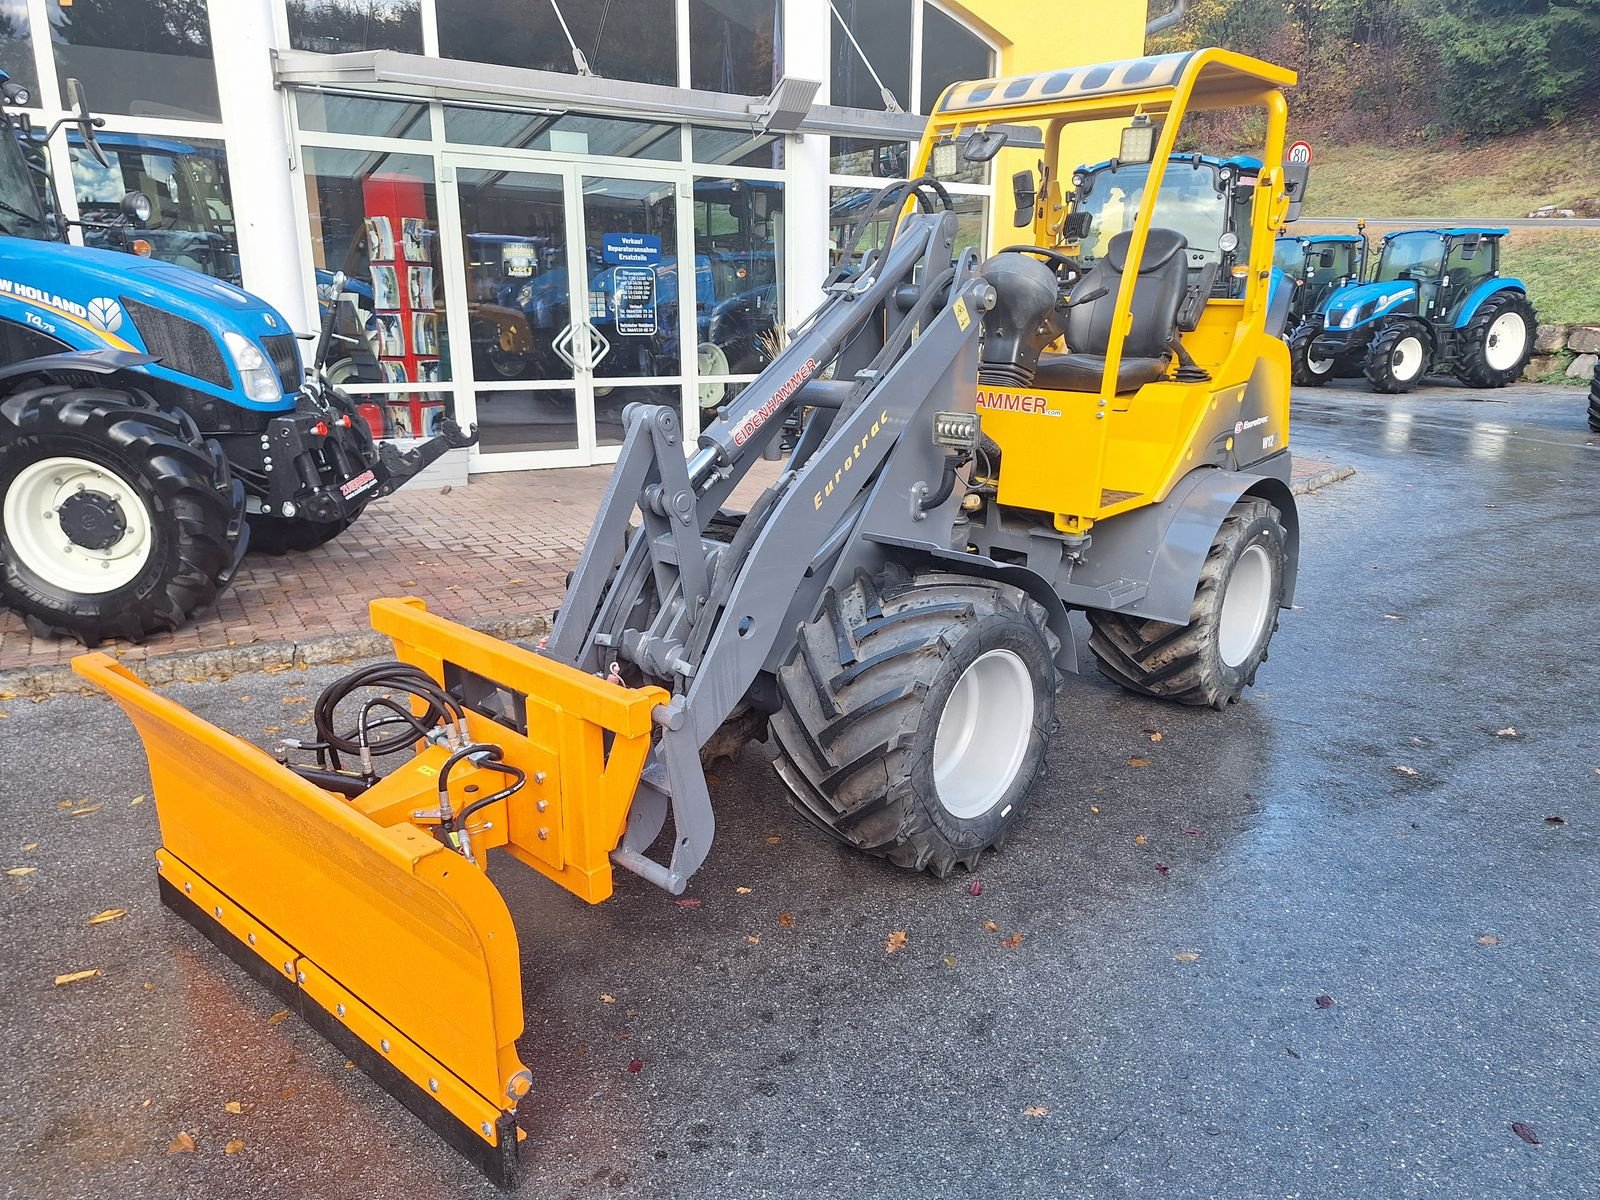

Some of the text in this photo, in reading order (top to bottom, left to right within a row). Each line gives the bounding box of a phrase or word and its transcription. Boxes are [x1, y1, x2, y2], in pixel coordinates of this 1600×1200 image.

[1293, 148, 1307, 162] 80
[607, 244, 658, 254] Reparaturannahme
[618, 253, 648, 261] Ersatzteile
[14, 282, 87, 319] HOLLAND
[733, 357, 816, 447] EIDENHAMMER
[814, 409, 888, 511] Eurotrac
